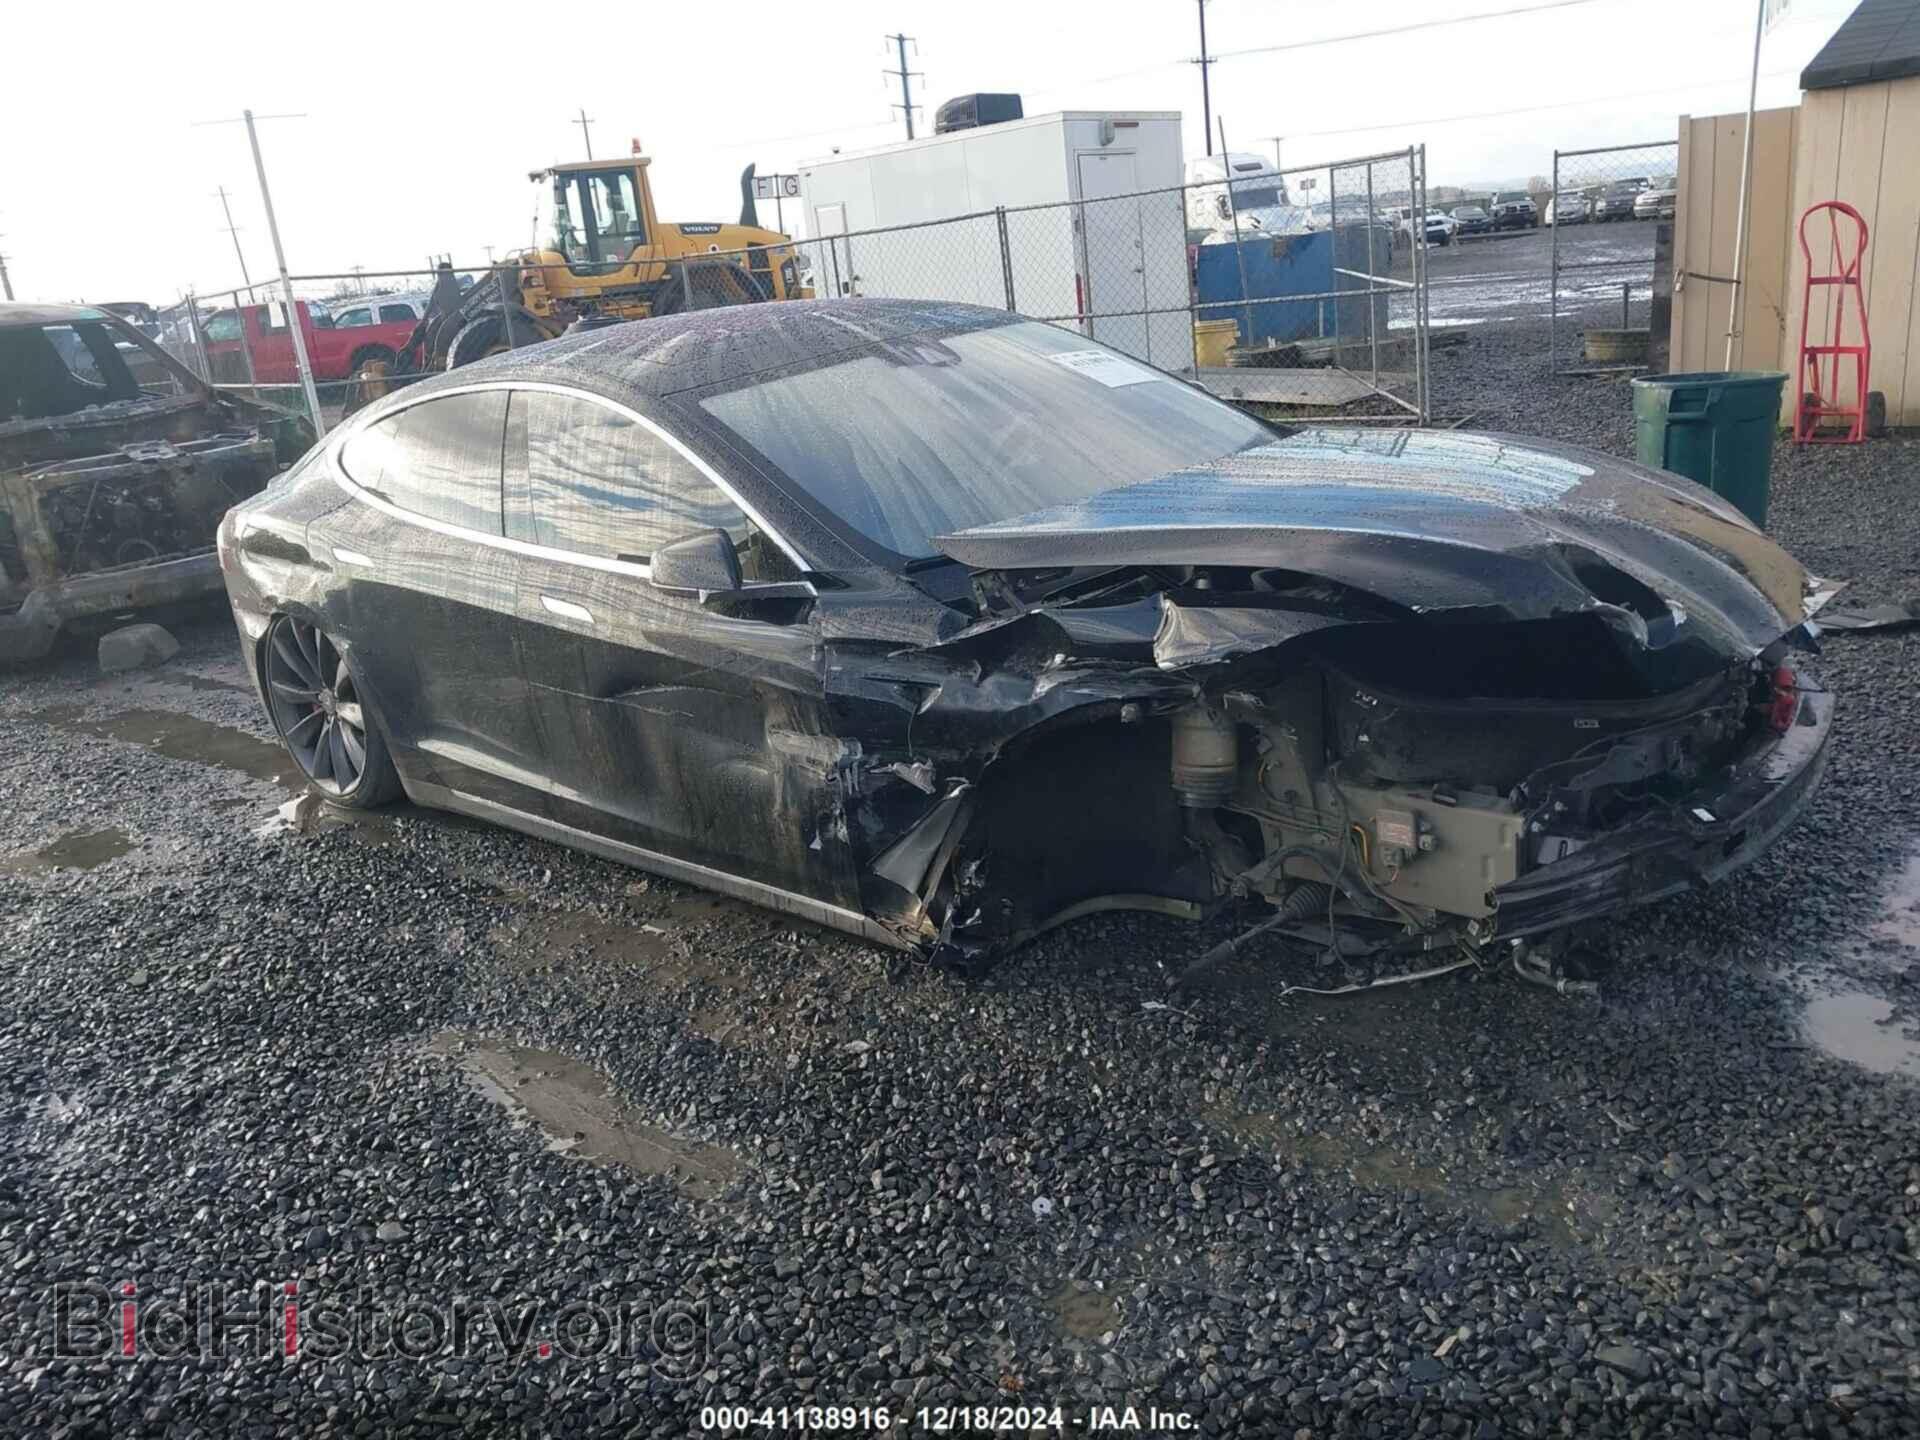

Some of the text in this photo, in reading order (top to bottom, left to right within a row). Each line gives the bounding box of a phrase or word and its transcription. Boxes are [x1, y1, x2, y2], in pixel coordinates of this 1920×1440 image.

[757, 178, 767, 196] F
[784, 176, 799, 196] G
[683, 225, 719, 233] VOLVO
